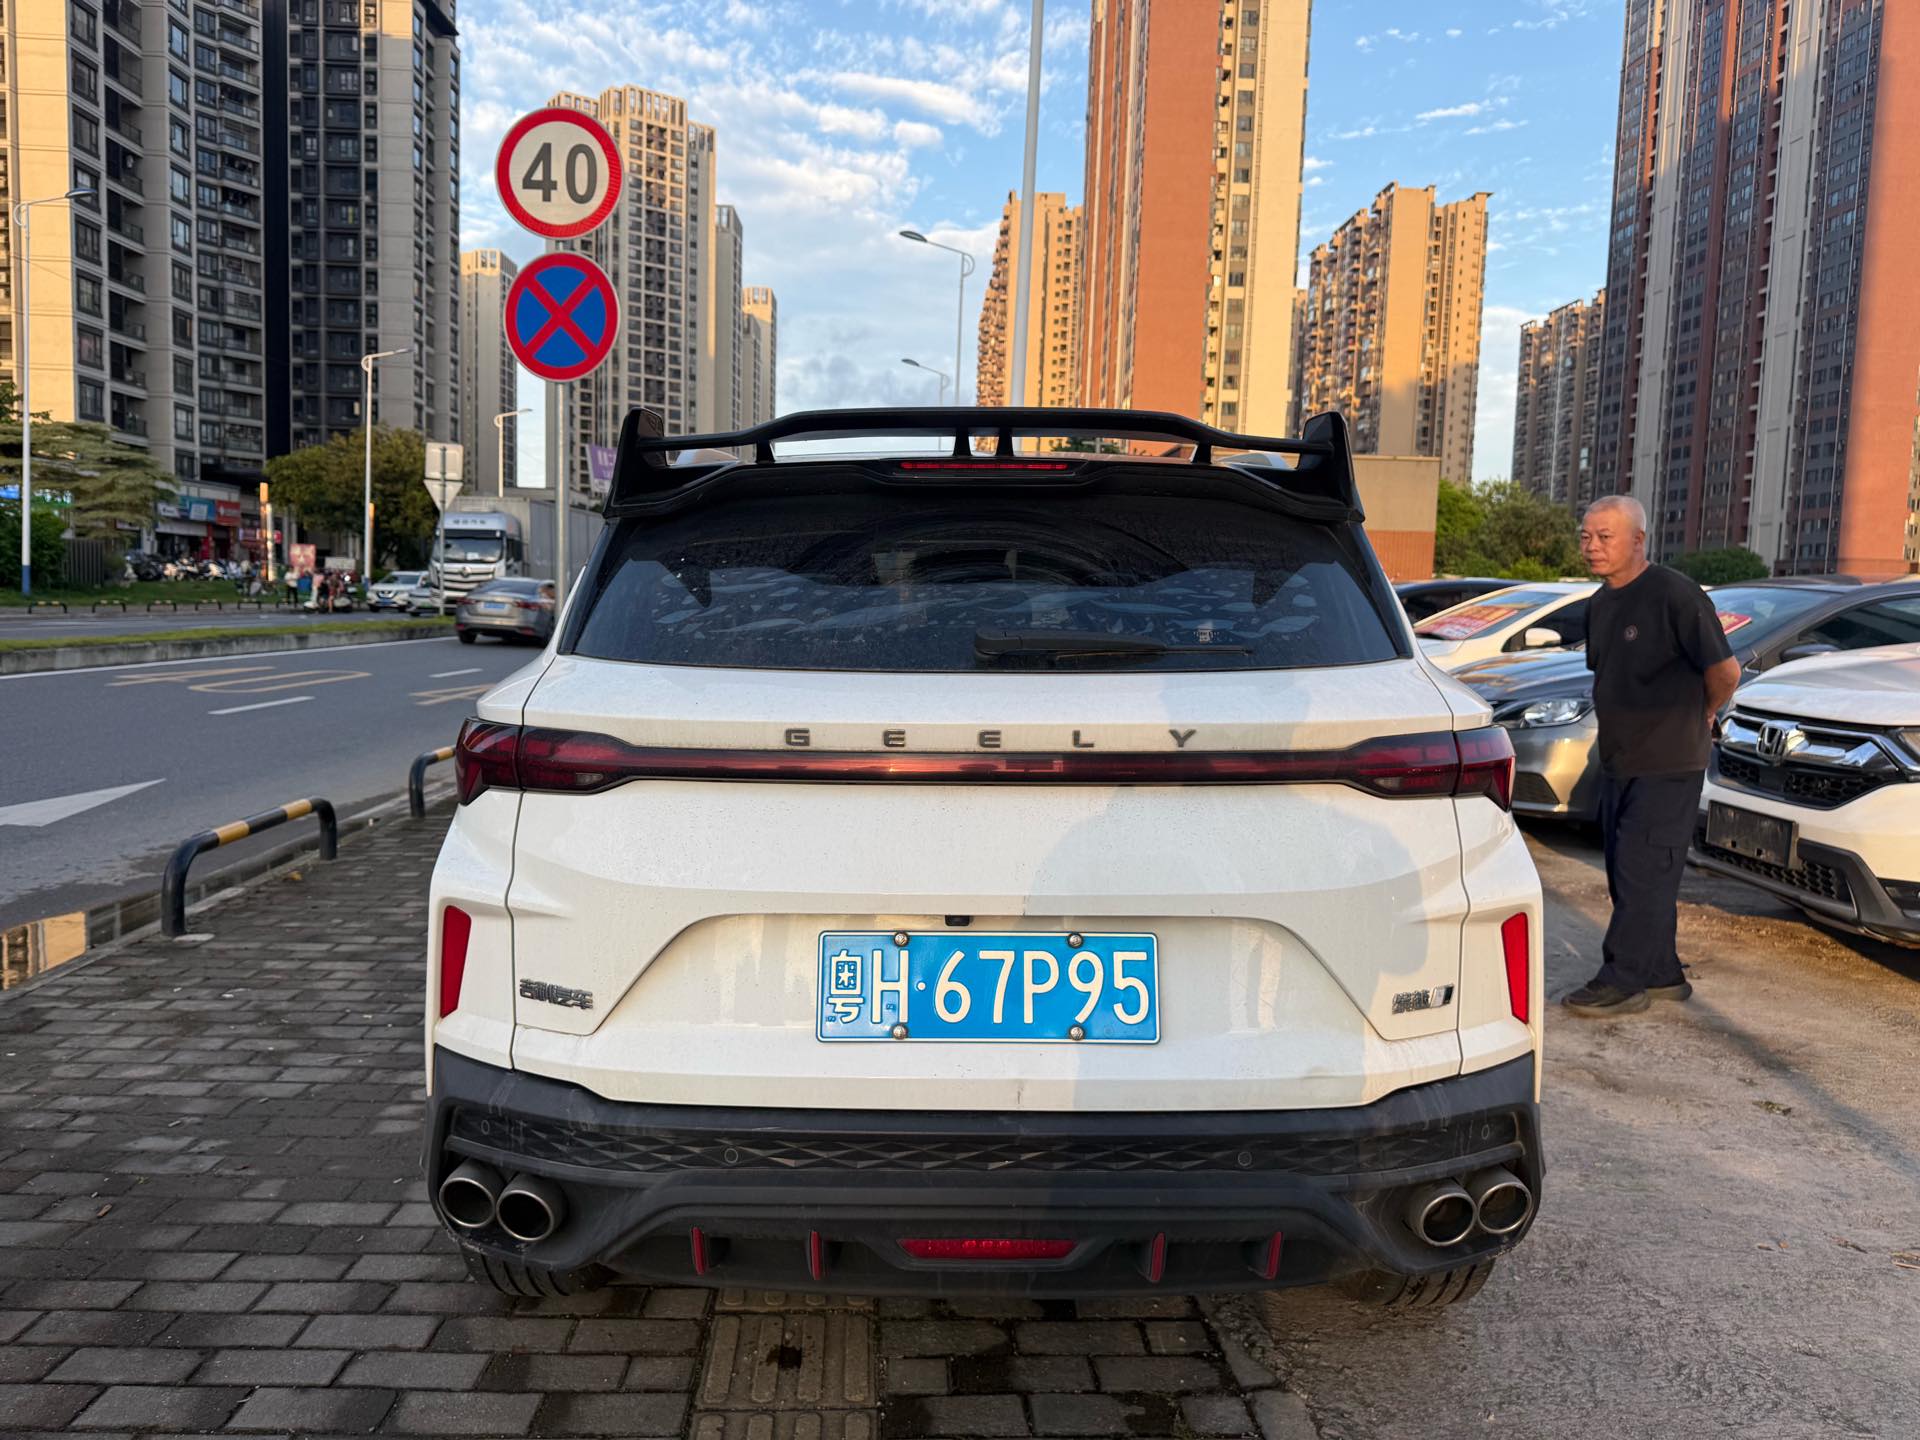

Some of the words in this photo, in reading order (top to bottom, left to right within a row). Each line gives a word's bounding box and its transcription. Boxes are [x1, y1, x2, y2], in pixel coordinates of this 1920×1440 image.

[522, 142, 598, 204] 40
[785, 728, 1197, 749] GEELY
[827, 948, 1150, 1025] 粤H·67P95
